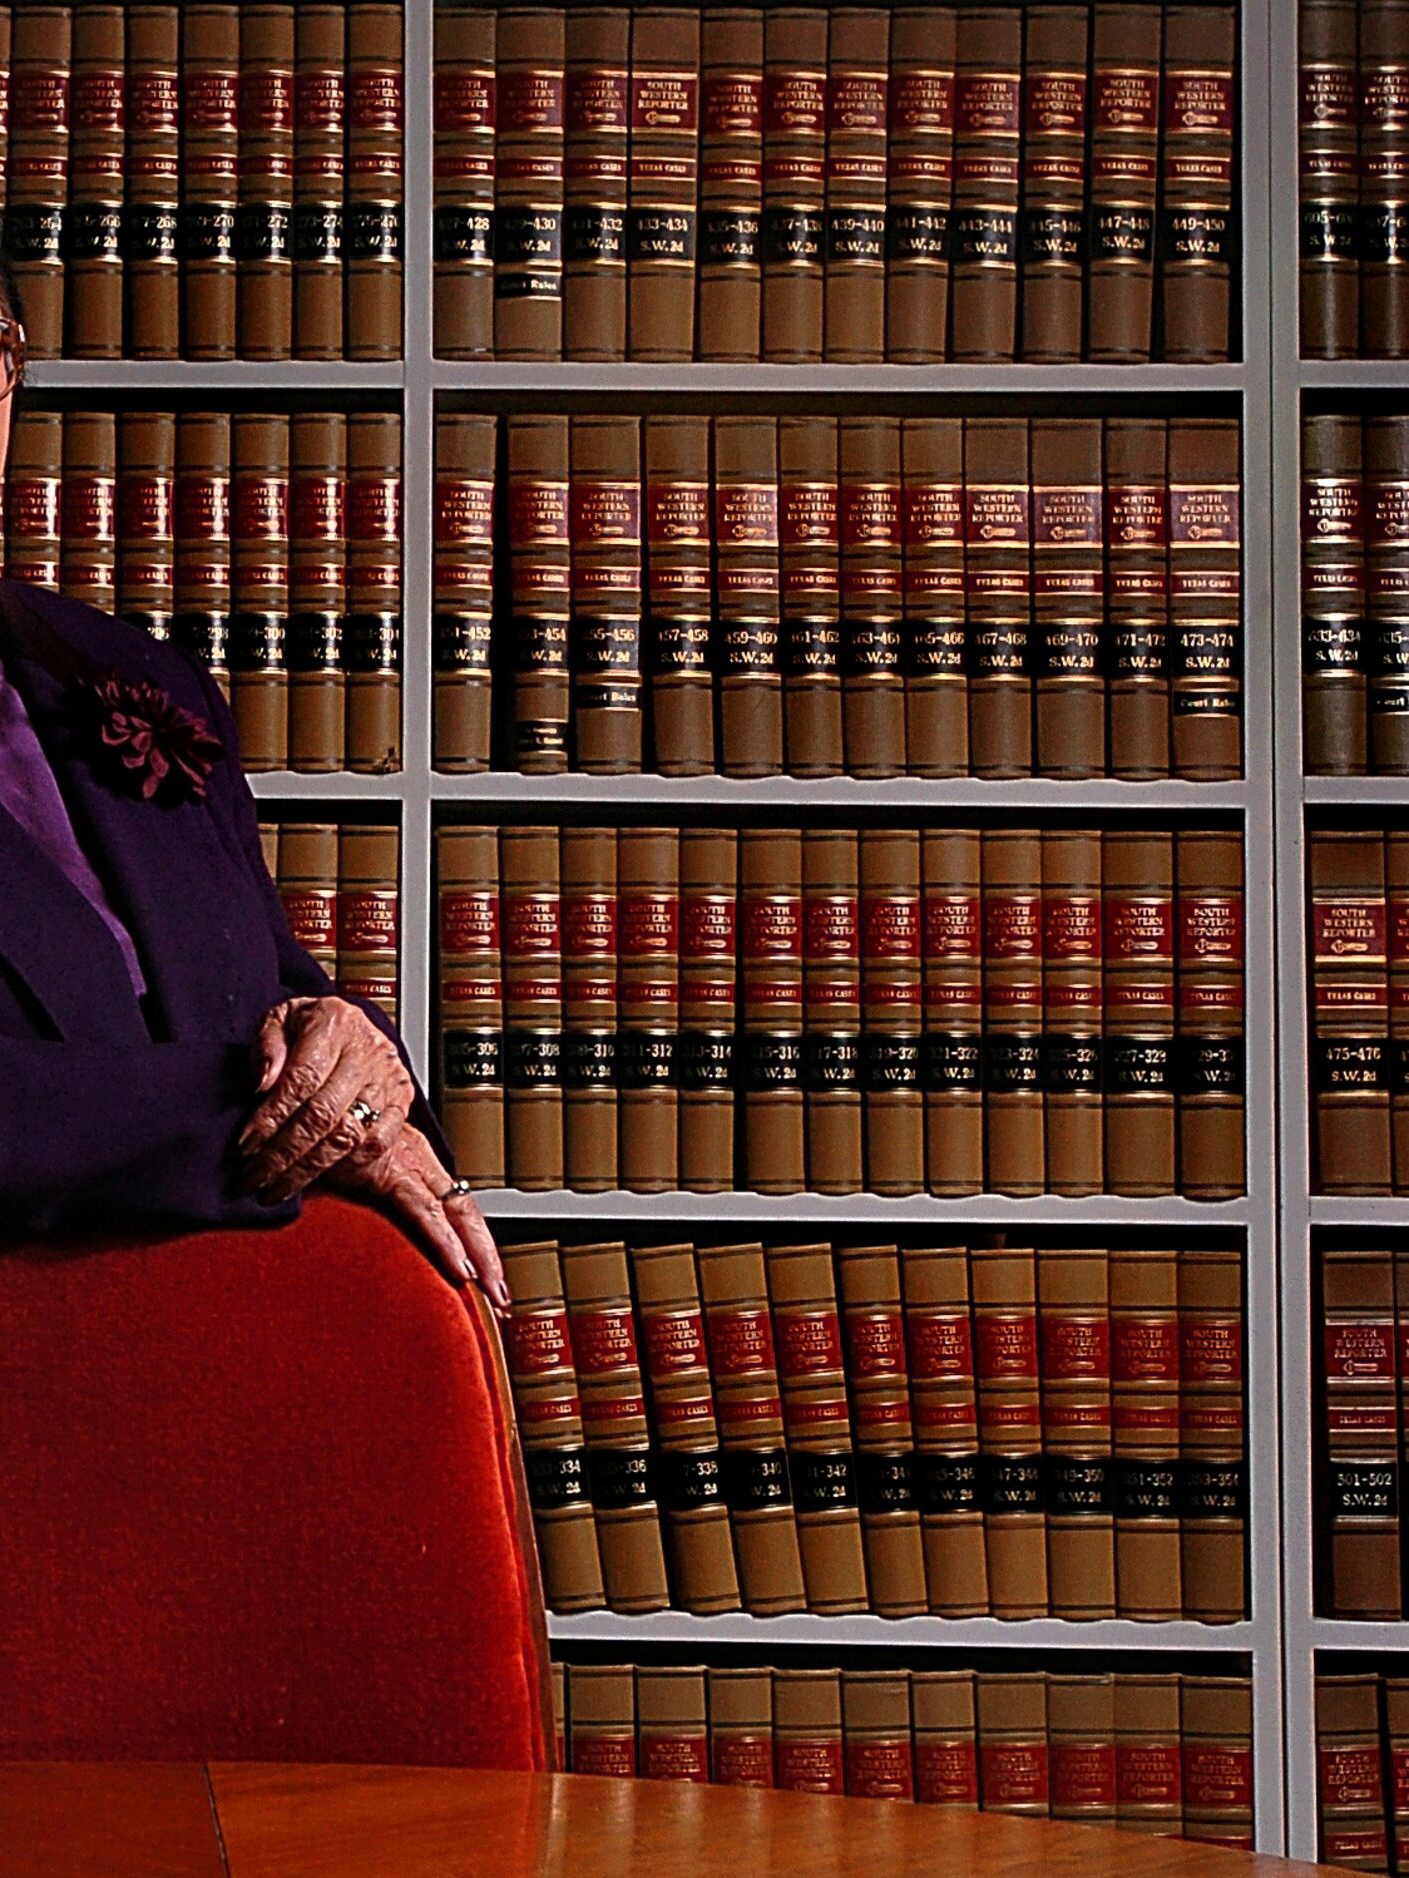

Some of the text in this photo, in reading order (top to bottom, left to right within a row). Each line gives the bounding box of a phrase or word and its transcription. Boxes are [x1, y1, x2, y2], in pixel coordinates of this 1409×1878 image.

[647, 81, 681, 91] SOUTH
[843, 81, 877, 91] SOUTH
[972, 83, 1006, 92] SOUTH
[1041, 82, 1075, 91] SOUTH
[1110, 79, 1144, 89] SOUTH
[1183, 81, 1218, 90] SOUTH
[1178, 91, 1224, 99] WESTERN
[1175, 101, 1226, 110] REPORTER
[1173, 217, 1225, 231] 449-450
[1176, 240, 1220, 252] S.W.2d
[664, 492, 697, 501] SOUTH
[732, 493, 766, 502] SOUTH
[980, 494, 1014, 503] SOUTH
[1050, 495, 1085, 504] SOUTH
[1121, 495, 1155, 504] SOUTH
[1187, 494, 1222, 503] SOUTH
[1182, 504, 1228, 513] WESTERN
[1180, 514, 1230, 523] REPORTER
[1181, 634, 1233, 647] 473-474
[1186, 657, 1230, 668] S.W.2d
[1194, 908, 1229, 916] SOUTH
[1332, 909, 1366, 917] SOUTH
[1324, 919, 1373, 927] WESTERN
[1323, 929, 1375, 937] REPORTER
[1332, 1071, 1377, 1081] S.W.2d
[519, 1320, 554, 1331] SOUTH
[1343, 1329, 1377, 1337] SOUTH
[1336, 1339, 1384, 1347] WESTERN
[1334, 1349, 1387, 1357] REPORTER
[1337, 1473, 1391, 1485] 501-502
[1343, 1495, 1387, 1505] S.W.2d
[1131, 1753, 1166, 1761] SOUTH
[1198, 1756, 1234, 1765] SOUTH
[1335, 1754, 1370, 1763] SOUTH
